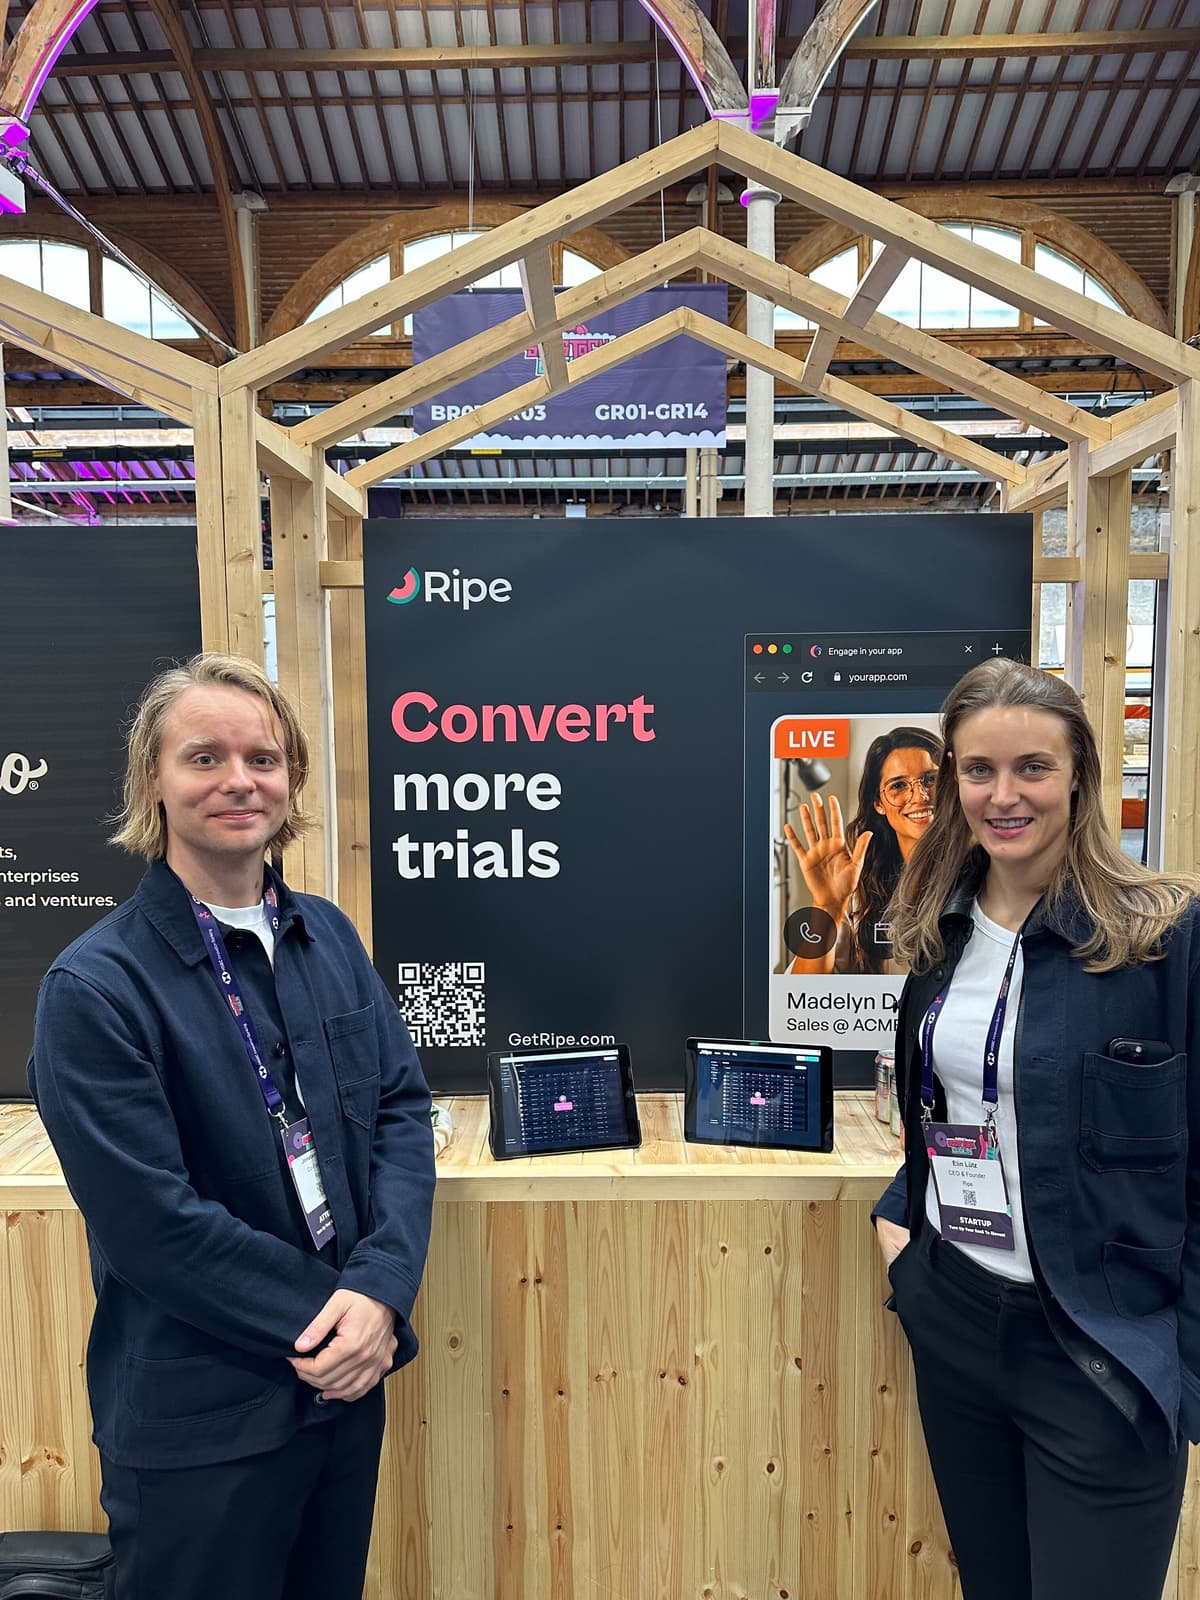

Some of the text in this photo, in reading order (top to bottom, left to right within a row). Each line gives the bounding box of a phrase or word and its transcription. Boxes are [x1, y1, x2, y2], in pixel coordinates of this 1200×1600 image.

[594, 403, 709, 421] GR01-GR14
[424, 568, 513, 610] Ripe
[828, 647, 903, 657] Engage in your app
[848, 673, 908, 684] yourapp.com
[391, 691, 656, 742] Convert
[788, 731, 836, 748] LIVE
[393, 772, 562, 811] more
[392, 829, 561, 879] trials
[4, 893, 118, 907] and ventures.
[787, 992, 876, 1014] Madelyn
[786, 1018, 830, 1032] Sales
[833, 1018, 850, 1035] @
[508, 1032, 616, 1048] GetRipe.com
[959, 1216, 992, 1228] STARTUP
